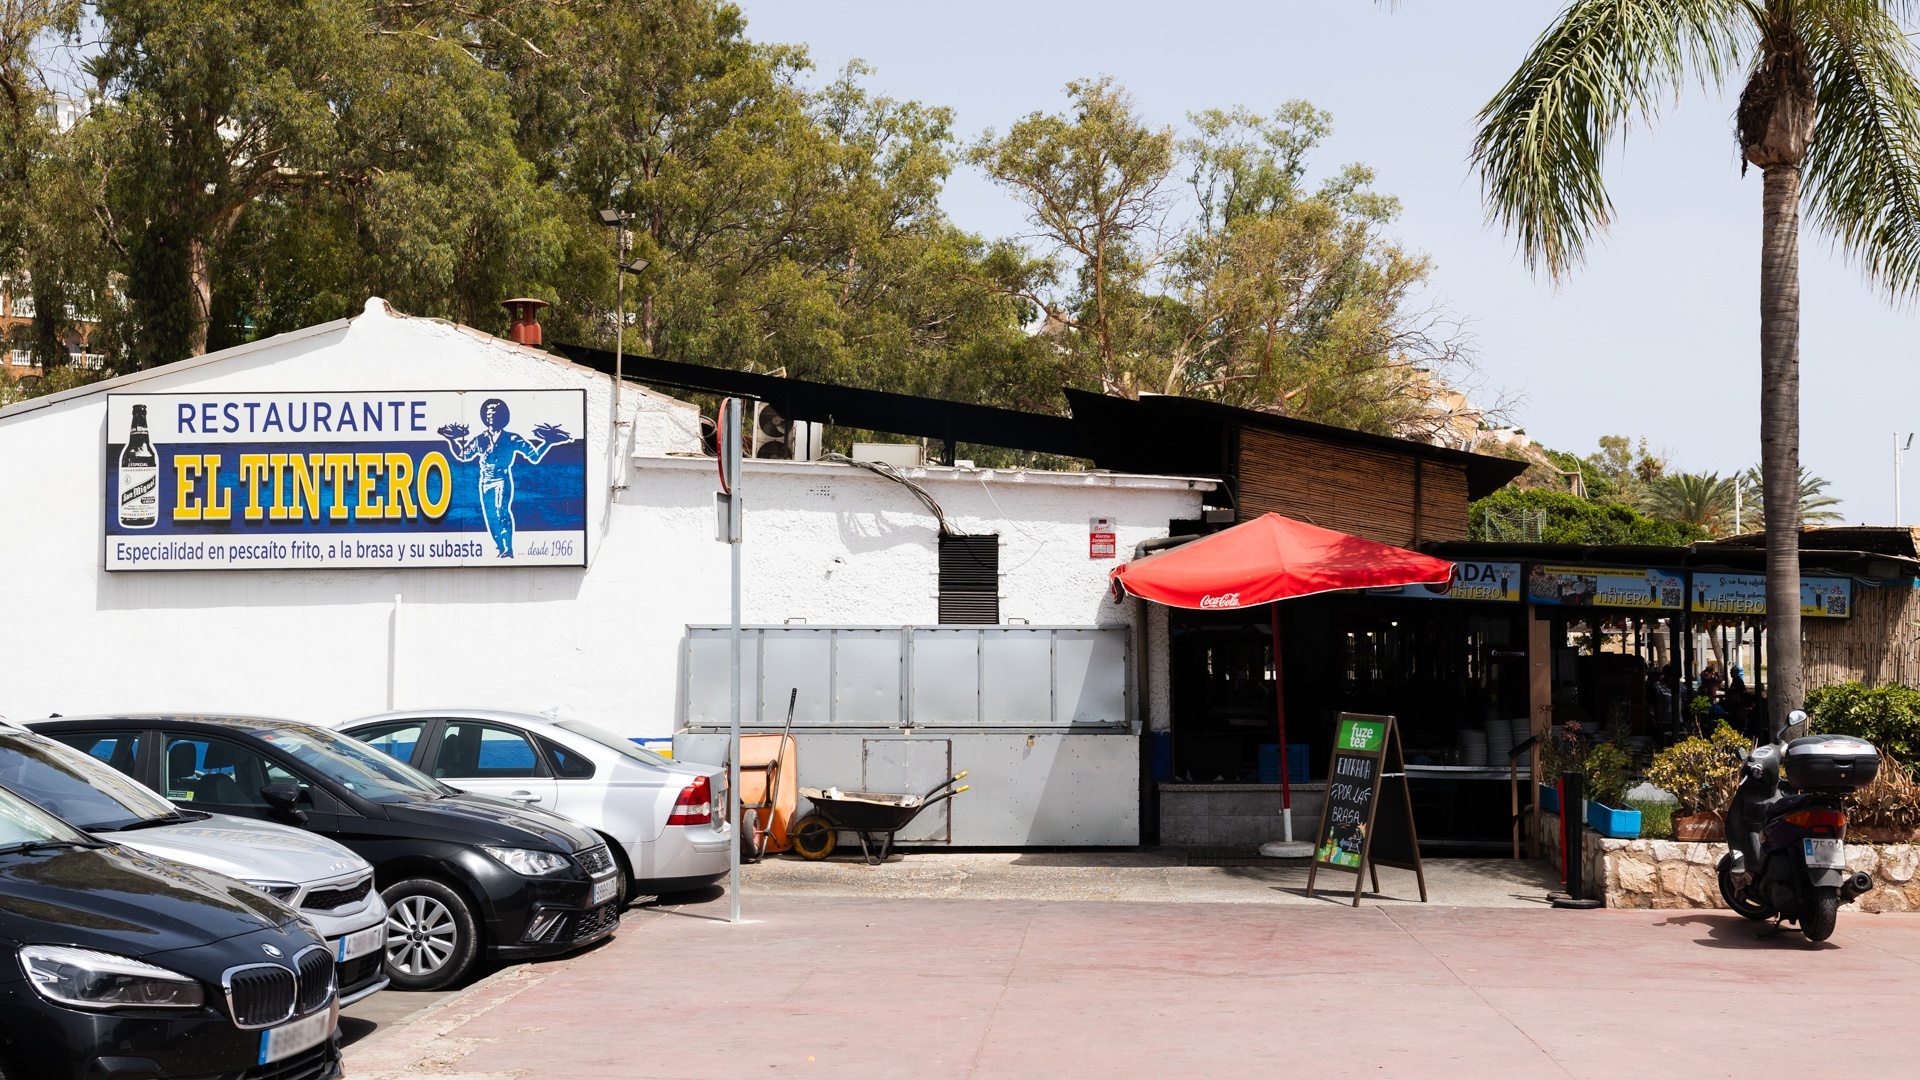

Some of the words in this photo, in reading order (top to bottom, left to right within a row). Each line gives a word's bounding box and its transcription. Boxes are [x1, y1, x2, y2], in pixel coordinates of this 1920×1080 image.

[178, 401, 427, 433] RESTAURANTE
[133, 477, 156, 498] Miguel
[173, 454, 232, 520] EL
[240, 452, 452, 520] TINTERO
[117, 542, 204, 564] Especialidad
[209, 546, 225, 561] en
[229, 541, 288, 563] pescaíto
[291, 541, 324, 562] frito,
[328, 545, 336, 559] a
[341, 541, 352, 559] la
[357, 541, 394, 559] brasa
[398, 545, 406, 561] y
[410, 544, 425, 558] su
[429, 540, 483, 558] subasta
[527, 541, 549, 556] desde
[550, 540, 573, 557] 1966
[1200, 592, 1241, 609] Coca-Cola
[1351, 723, 1374, 739] fuze
[1350, 736, 1366, 748] tea
[1337, 757, 1371, 780] ENTRADA
[1338, 783, 1352, 801] POR
[1331, 806, 1361, 825] BRASA
